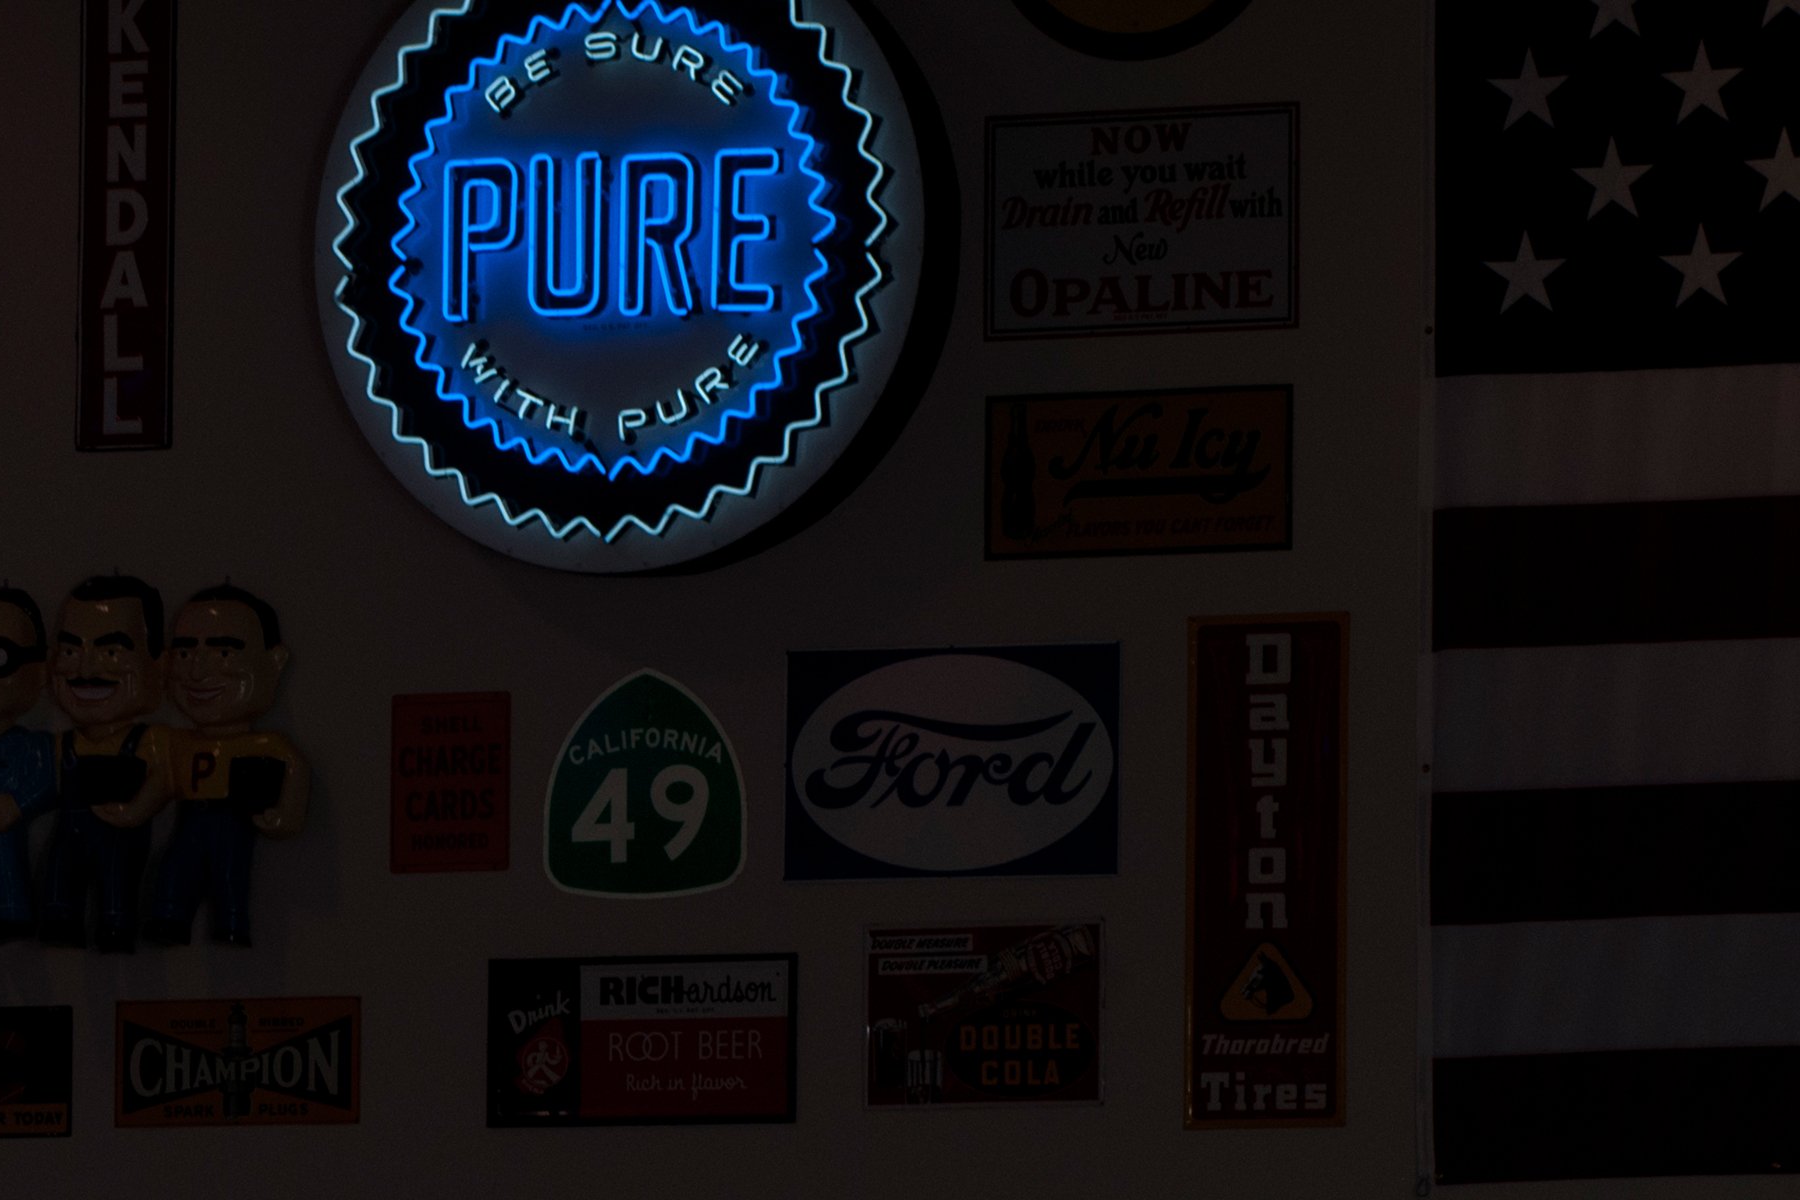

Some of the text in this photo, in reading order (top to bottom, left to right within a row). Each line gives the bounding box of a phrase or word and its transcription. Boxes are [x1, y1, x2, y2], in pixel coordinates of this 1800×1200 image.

[485, 31, 744, 112] BE SURE
[1090, 122, 1192, 156] NOW
[1033, 153, 1247, 194] while you wait
[100, 0, 150, 436] KENDALL
[1001, 183, 1283, 233] Drain and Refill with
[442, 148, 781, 323] PURE
[1102, 231, 1169, 266] New
[1009, 267, 1274, 318] OPALINE
[460, 333, 760, 441] WITH PURE
[1049, 401, 1163, 480] Nu
[398, 743, 502, 778] CHARGE
[567, 727, 724, 765] CALIFORNIA
[804, 709, 1096, 809] Ford
[191, 752, 216, 793] P
[1243, 631, 1292, 931] Dayton
[405, 788, 495, 822] CARDS
[570, 763, 711, 864] 49
[918, 936, 970, 949] MEASURE
[926, 956, 982, 970] PLEASURE
[506, 989, 572, 1035] Drink
[607, 1029, 764, 1063] ROOT BEER
[958, 1022, 1082, 1052] DOUBLE
[1200, 1031, 1329, 1057] Thorobred
[129, 1028, 343, 1098] CHAMPION
[980, 1059, 1061, 1087] COLA
[625, 1072, 749, 1101] Rich in flavor
[1200, 1069, 1327, 1112] Tires
[14, 1109, 63, 1126] TODAY
[163, 1101, 309, 1119] SPARK PLUGS
